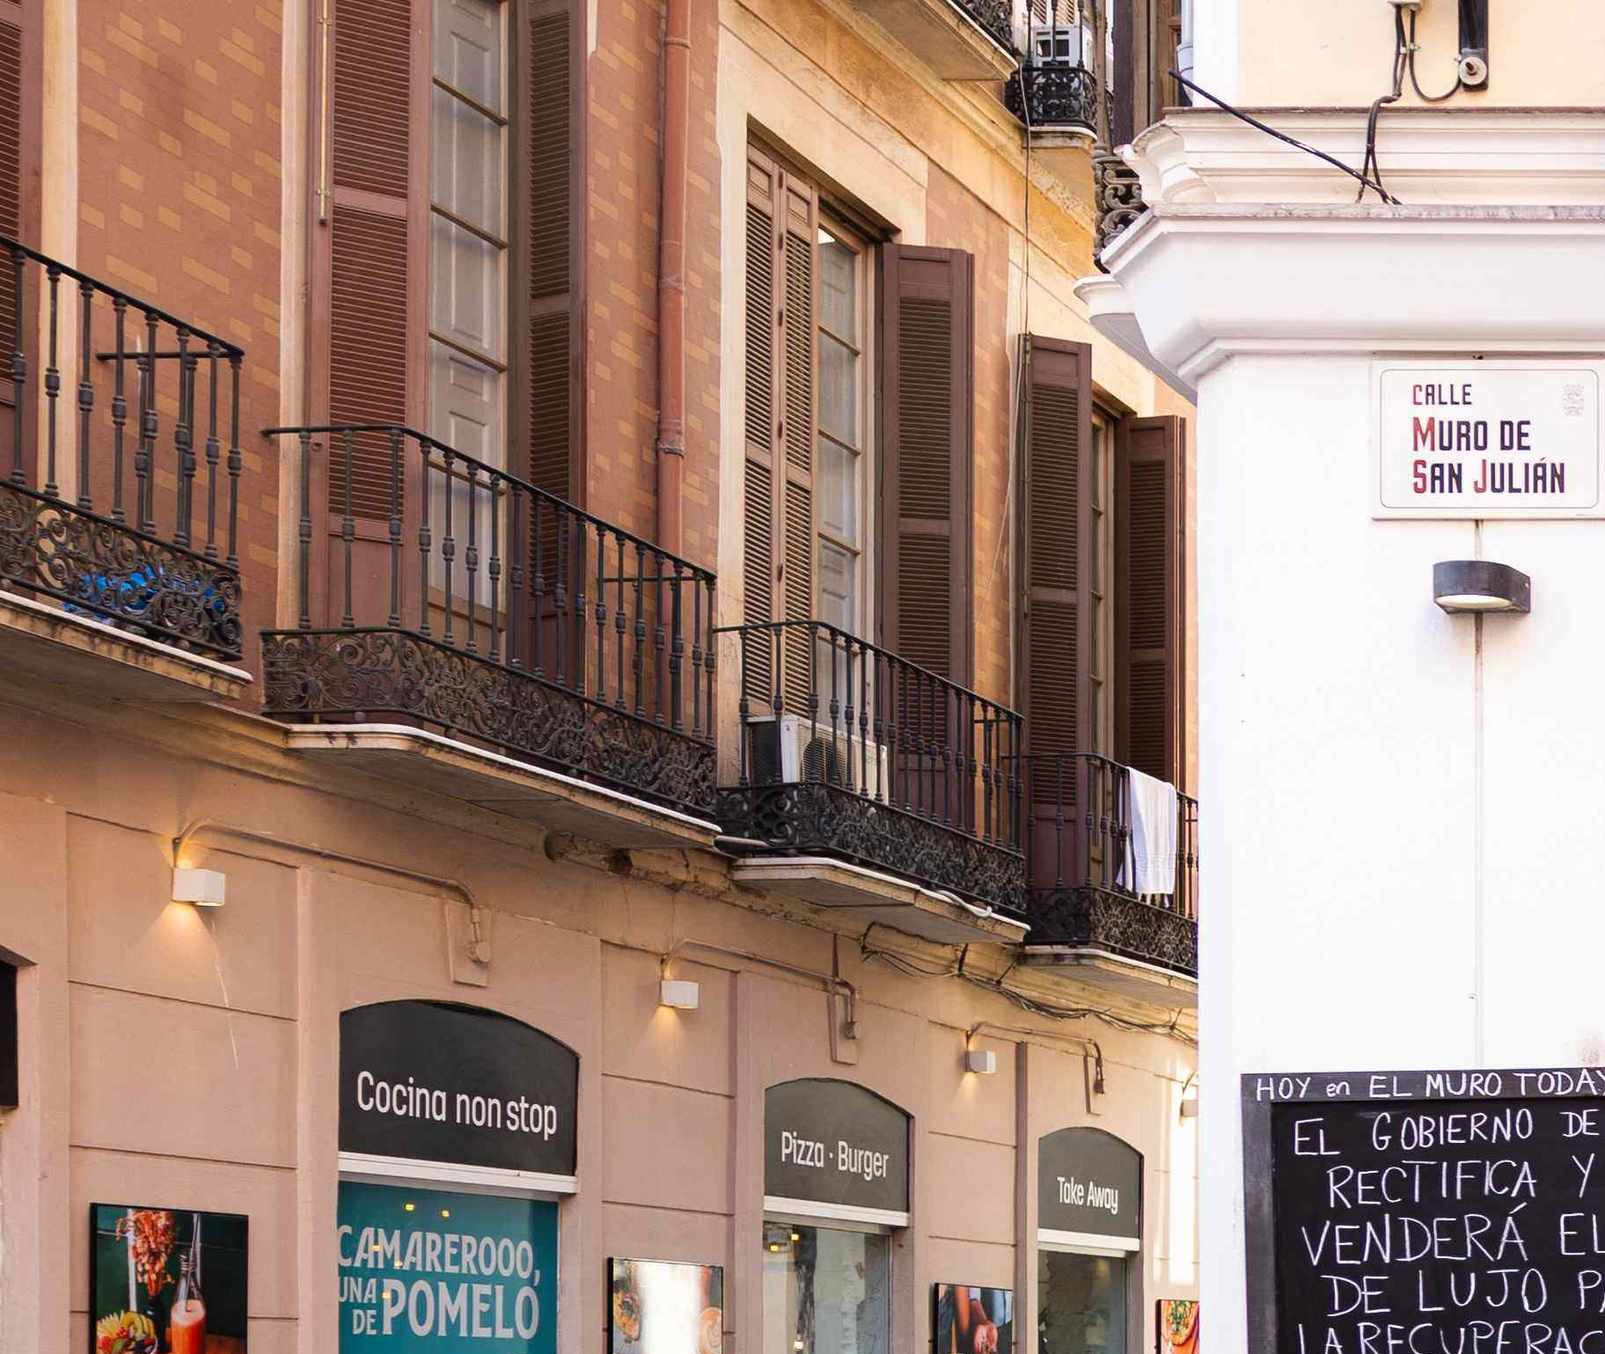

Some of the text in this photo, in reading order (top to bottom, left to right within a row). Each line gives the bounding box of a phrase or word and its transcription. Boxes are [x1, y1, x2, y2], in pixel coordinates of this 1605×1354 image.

[1412, 383, 1473, 406] CALLE
[1412, 416, 1532, 452] MURO DE
[1412, 456, 1566, 494] SAN JULIÁN
[357, 1070, 557, 1141] Cocina non stop
[1256, 1076, 1310, 1101] HOY
[1326, 1080, 1350, 1097] en
[1368, 1075, 1413, 1098] EL
[1425, 1072, 1502, 1098] MURO
[781, 1130, 889, 1181] Pizza Burger
[1294, 1117, 1341, 1156] EL
[1372, 1108, 1533, 1151] GOBIERNO
[1559, 1108, 1600, 1138] DE
[1057, 1176, 1119, 1215] Take Away
[1326, 1159, 1537, 1210] RECTIFICA
[1571, 1152, 1595, 1198] Y
[337, 1224, 541, 1287] CAMAREROOO,
[1301, 1200, 1529, 1266] VENDERÁ
[338, 1276, 377, 1304] UNA
[352, 1278, 540, 1340] DE POMELO
[1320, 1274, 1391, 1317] DE
[1418, 1267, 1548, 1313] LUJO
